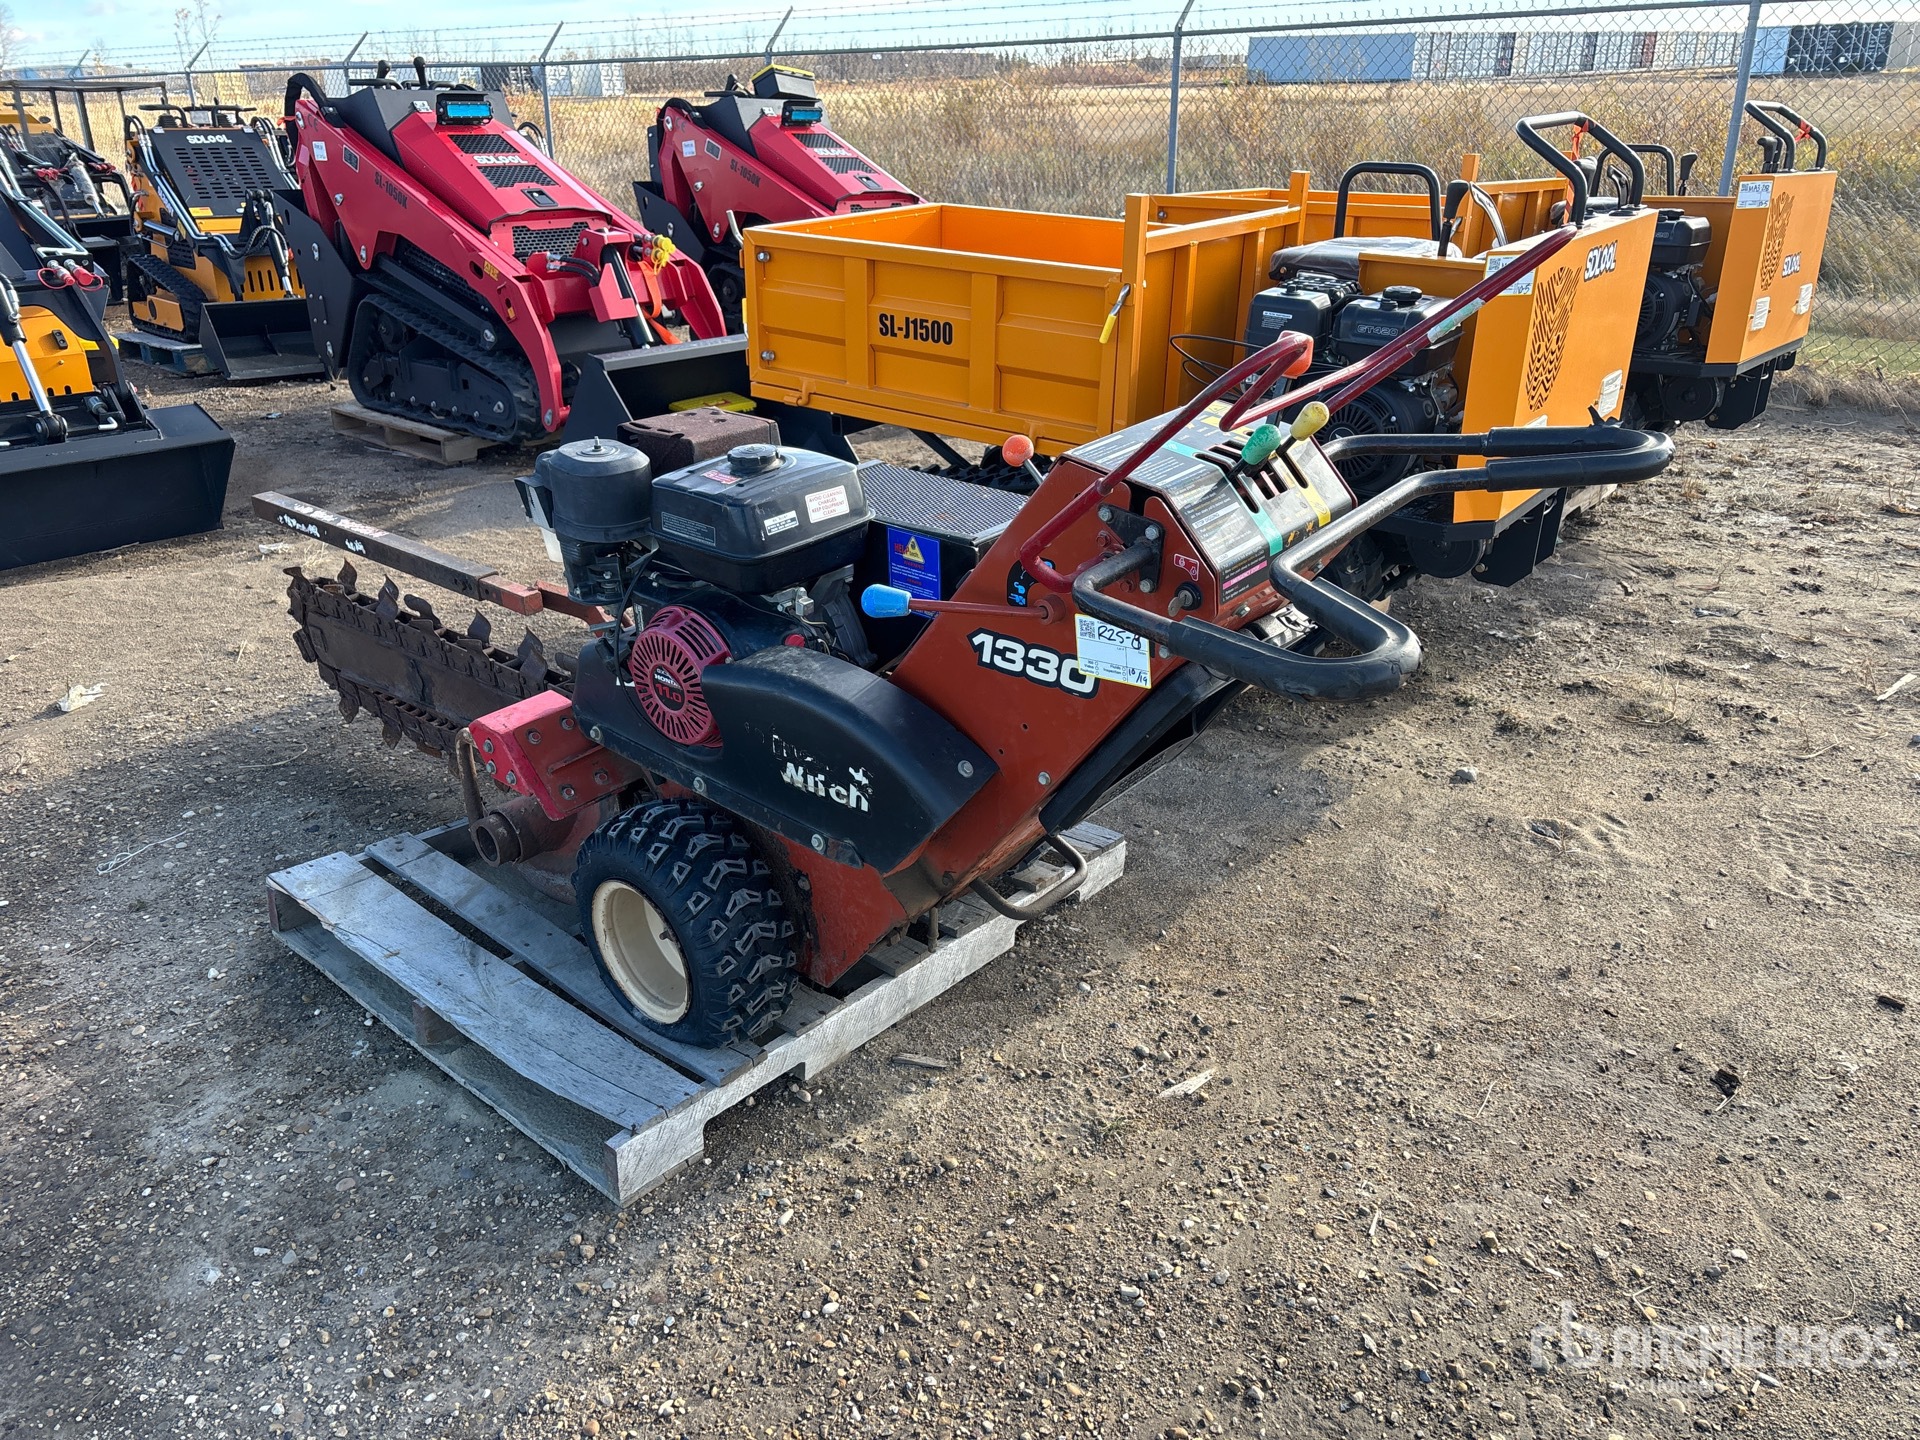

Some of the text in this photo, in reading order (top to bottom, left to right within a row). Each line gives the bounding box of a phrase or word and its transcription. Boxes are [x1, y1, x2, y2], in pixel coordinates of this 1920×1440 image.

[186, 134, 233, 144] SDLOOL
[473, 155, 528, 165] SDLOOL
[729, 158, 761, 188] SL-1050K
[374, 171, 408, 209] SL-1050K
[1584, 241, 1617, 281] SDLOOL
[879, 313, 953, 345] SL-J1500
[1357, 324, 1399, 337] GT420
[809, 490, 843, 503] AVOID CLEANING
[818, 497, 837, 506] CHARGES
[822, 500, 845, 510] EQUIPMENT
[1097, 625, 1142, 650] R25-8
[971, 632, 1096, 694] 1330
[655, 683, 682, 703] 11.0
